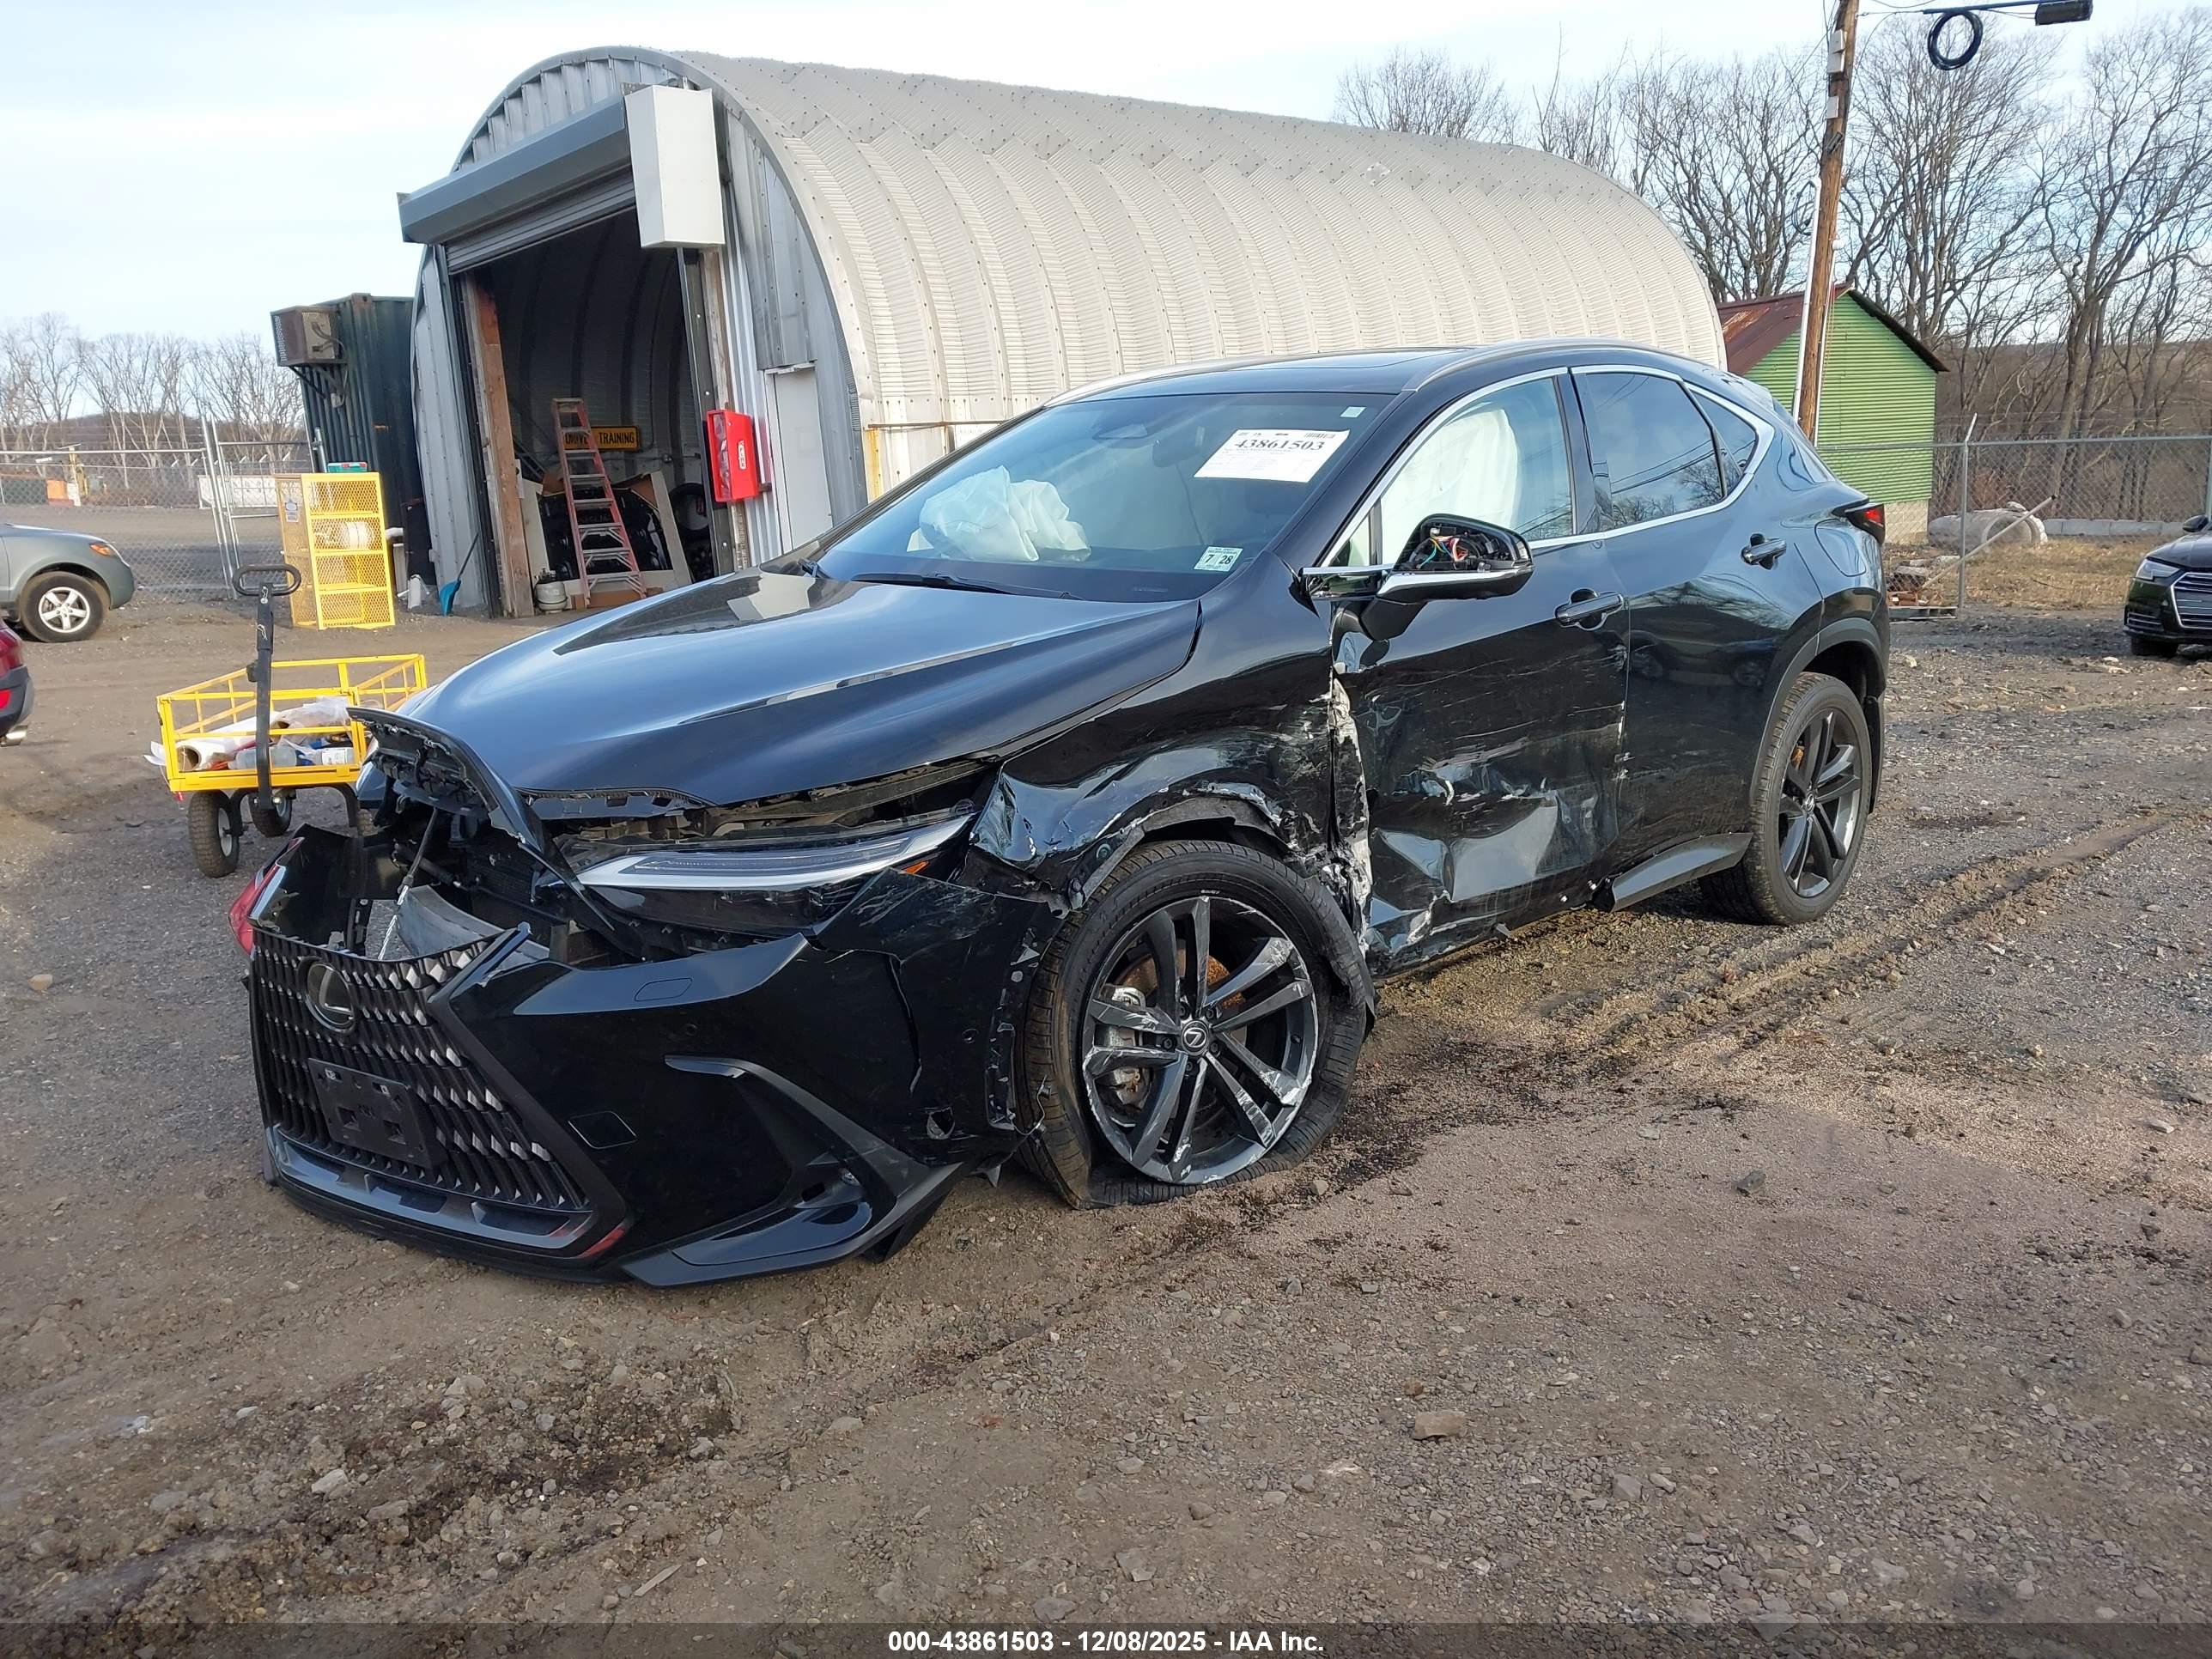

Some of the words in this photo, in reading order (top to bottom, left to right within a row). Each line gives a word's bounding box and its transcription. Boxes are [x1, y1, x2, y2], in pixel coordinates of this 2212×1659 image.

[599, 432, 635, 444] TRAINING
[1234, 439, 1325, 451] 43861503
[1205, 554, 1216, 563] 7
[1218, 555, 1234, 565] 28
